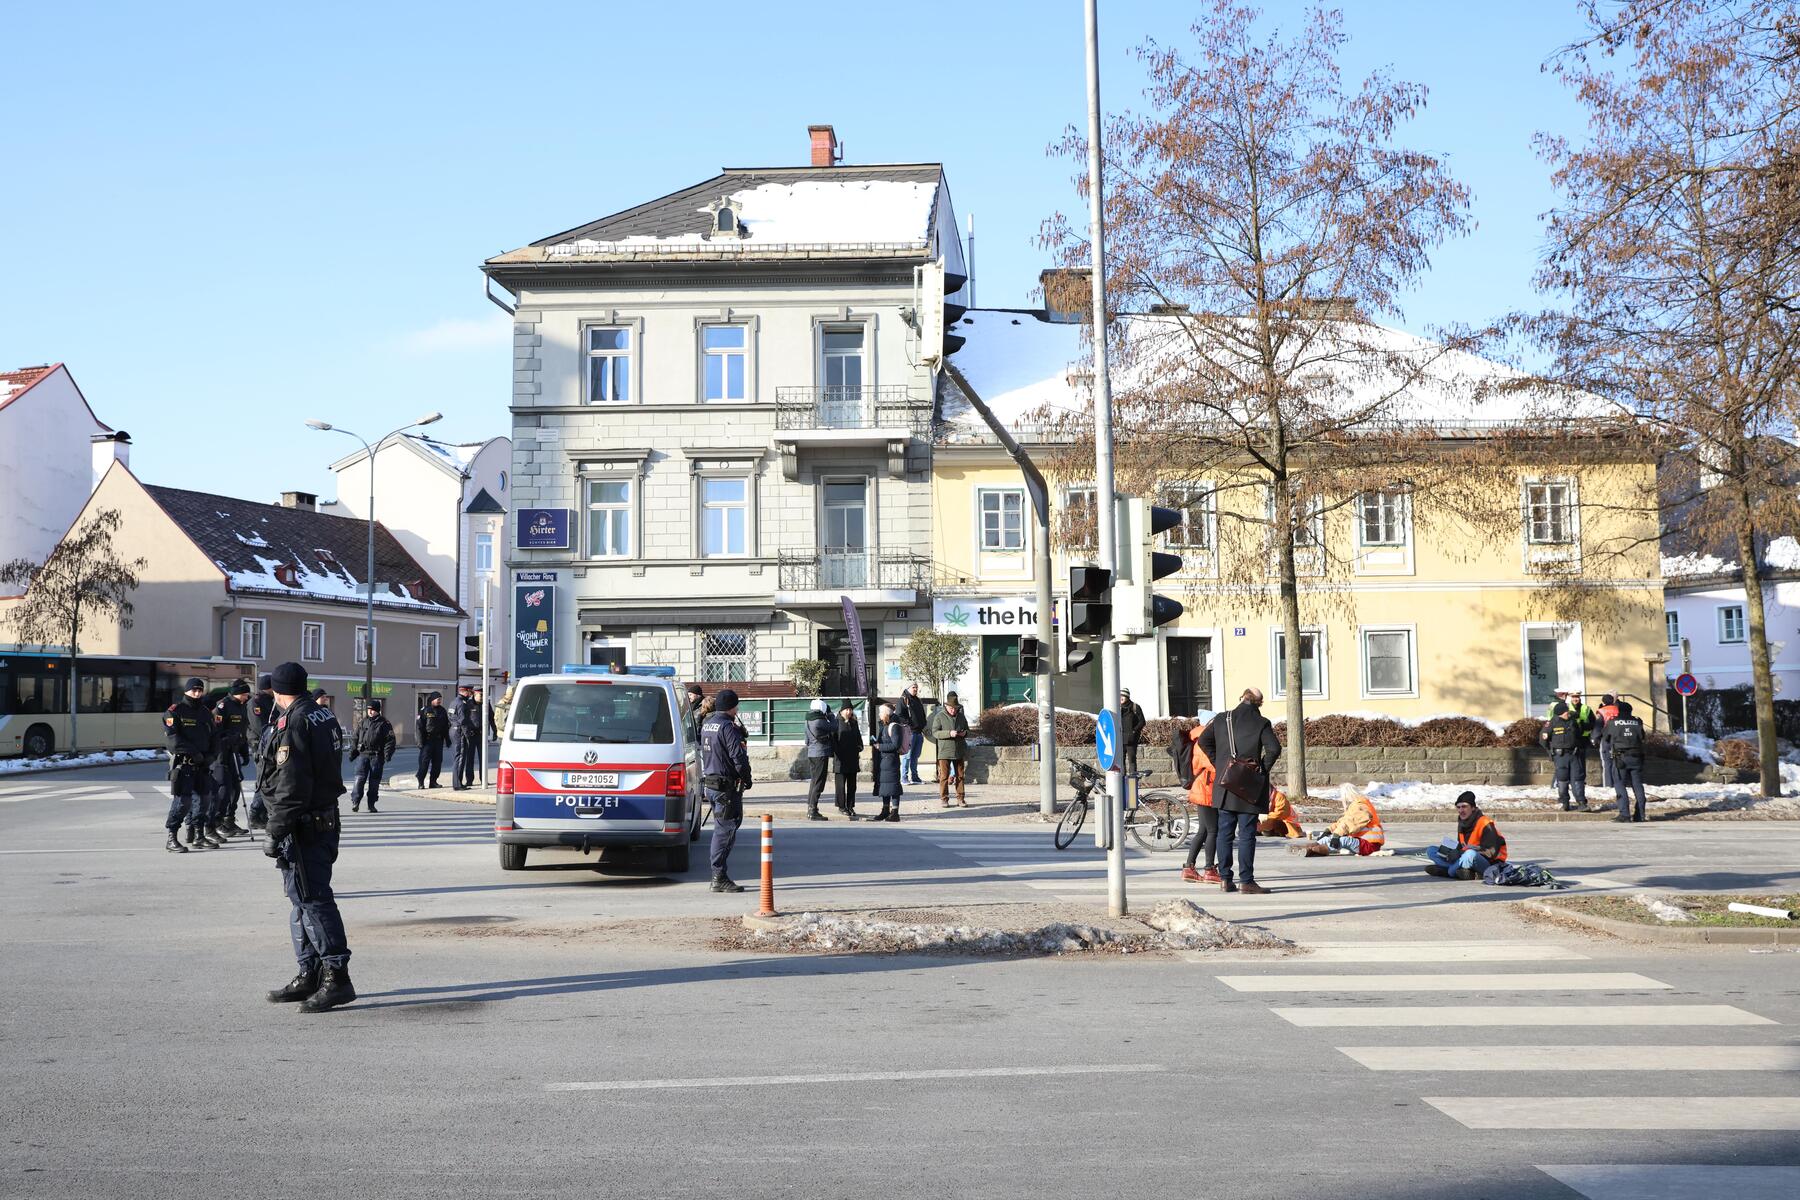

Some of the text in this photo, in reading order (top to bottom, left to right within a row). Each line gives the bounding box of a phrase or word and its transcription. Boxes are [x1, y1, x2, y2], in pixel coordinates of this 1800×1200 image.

[530, 525, 556, 537] Hirter
[542, 573, 554, 581] Ring
[978, 606, 1015, 625] the
[517, 631, 538, 641] WOHN
[523, 639, 549, 650] ZIMMER
[571, 774, 614, 784] BP 21052
[555, 795, 619, 807] POLIZEI
